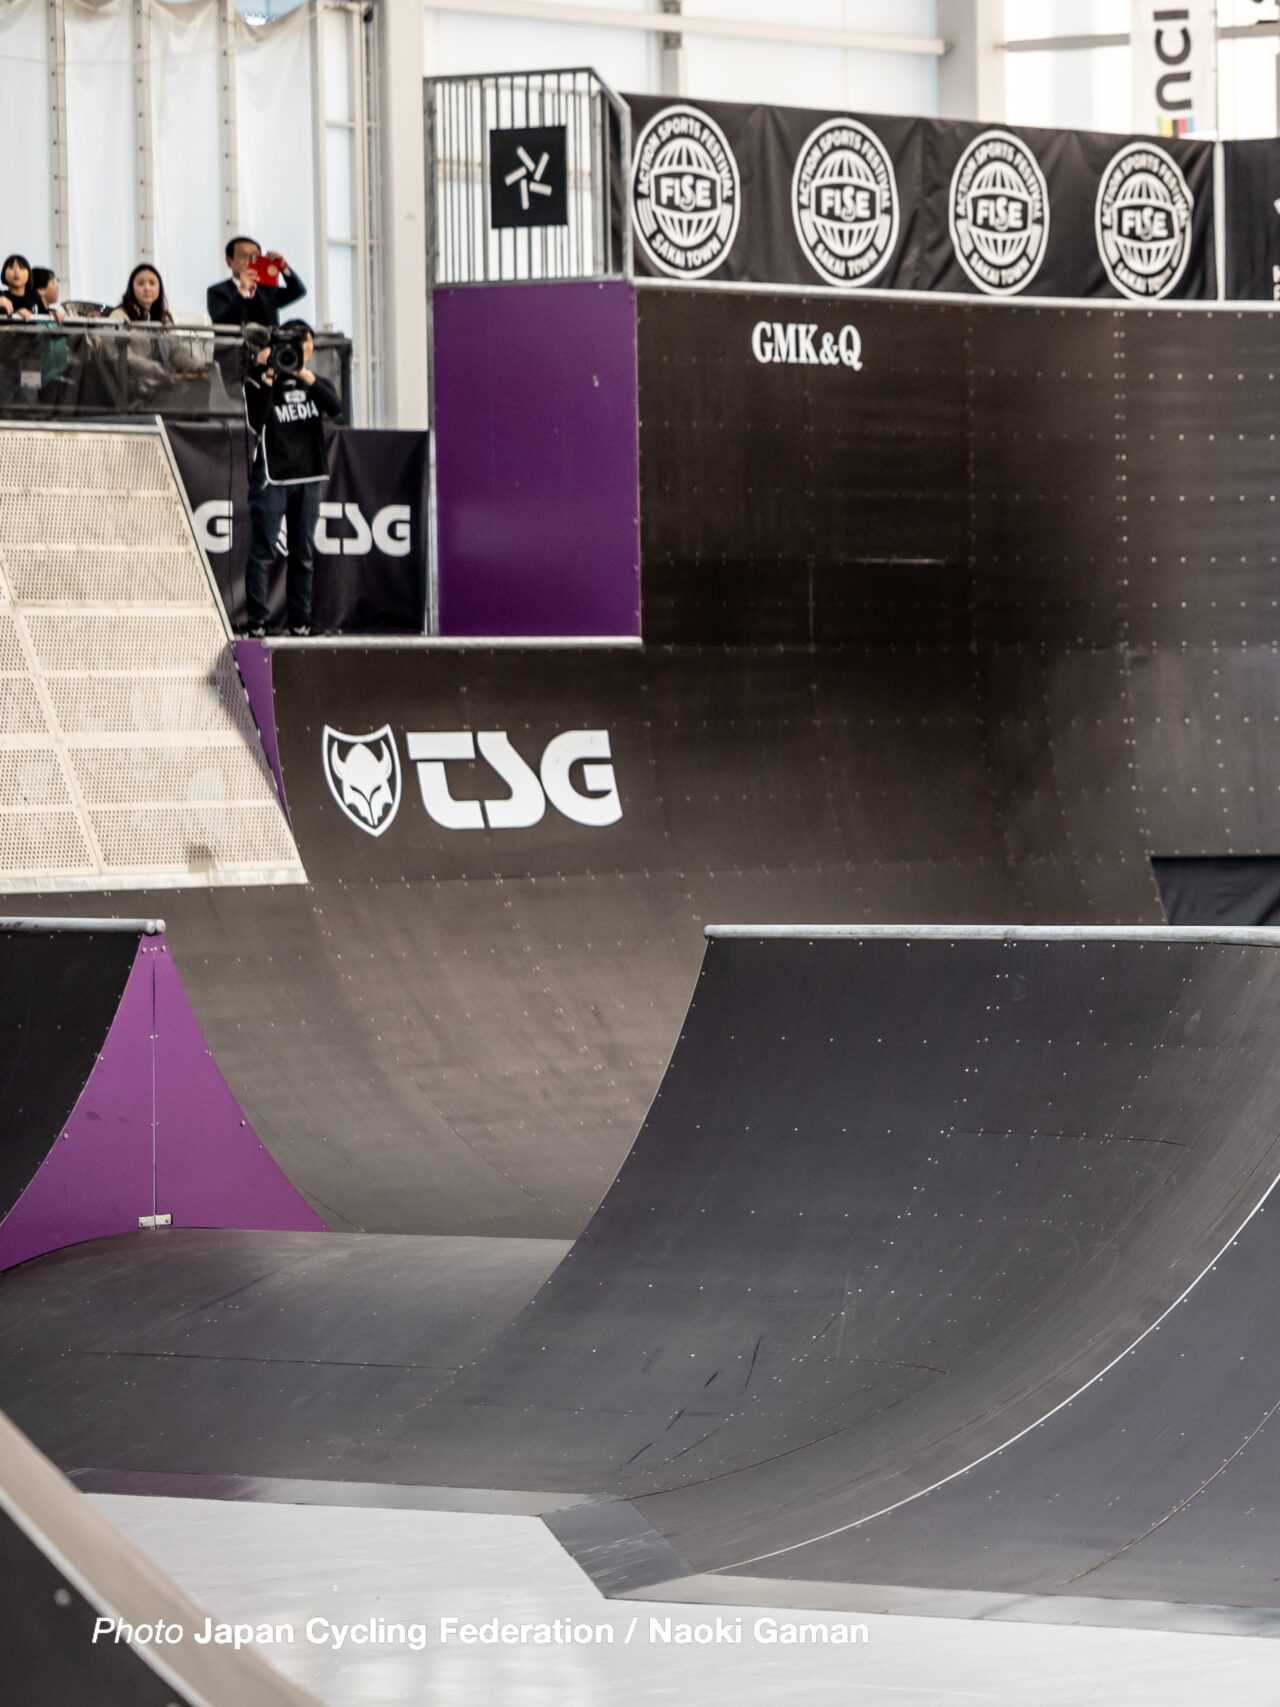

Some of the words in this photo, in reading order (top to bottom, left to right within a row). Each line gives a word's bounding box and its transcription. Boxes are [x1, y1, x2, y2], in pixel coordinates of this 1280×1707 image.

[1153, 9, 1192, 111] UCI
[637, 132, 660, 196] ACTION
[657, 116, 702, 141] SPORTS
[700, 127, 734, 200] FESTIVAL
[799, 144, 823, 207] ACTION
[819, 128, 862, 153] SPORTS
[861, 140, 892, 211] FESTIVAL
[660, 174, 712, 212] FISE
[821, 185, 871, 222] FISE
[976, 196, 1023, 232] FISE
[1121, 206, 1168, 240] FISE
[651, 233, 686, 268] SAKAI
[687, 236, 722, 268] TOWN
[847, 245, 879, 277] TOWN
[751, 320, 863, 371] GMK&Q
[274, 399, 320, 424] MEDIA
[406, 729, 623, 831] TSG
